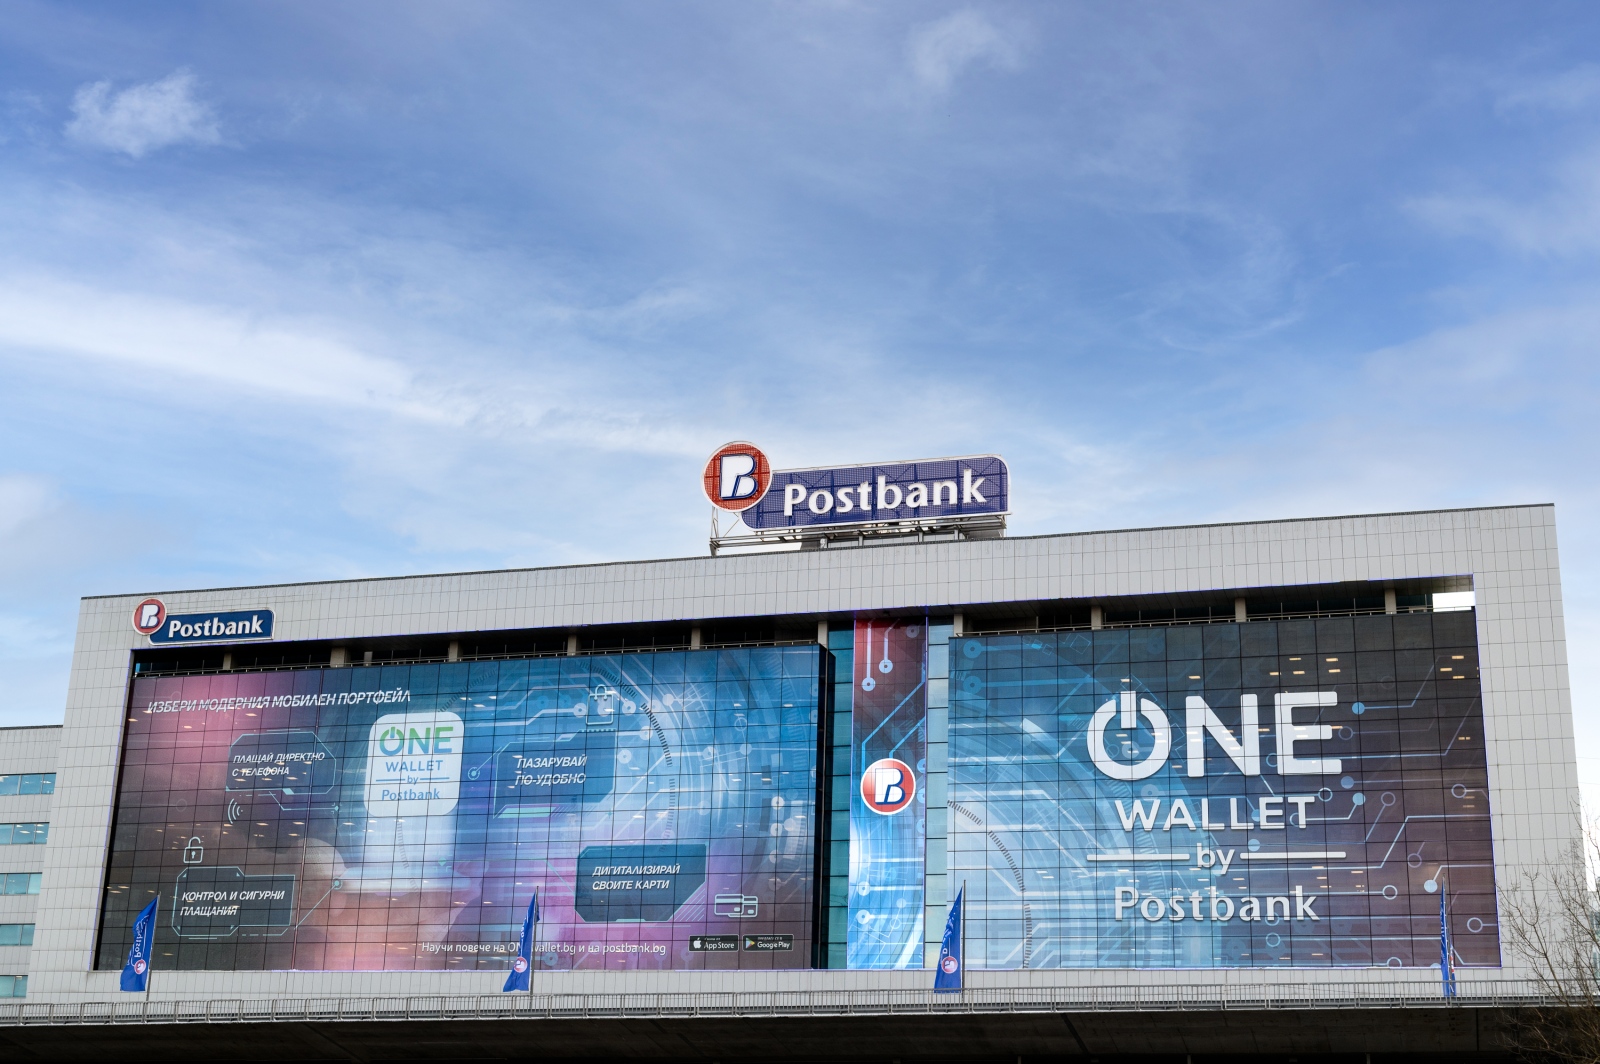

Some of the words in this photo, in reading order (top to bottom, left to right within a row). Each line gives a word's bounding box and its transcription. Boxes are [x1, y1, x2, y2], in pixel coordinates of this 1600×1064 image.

[784, 468, 987, 516] Postbank
[168, 615, 264, 638] Postbank
[148, 700, 197, 713] ИЗБЕРИ
[198, 696, 271, 713] МОДЕРНИЯ
[271, 693, 337, 708] МОБИЛЕН
[337, 687, 411, 705] ПОРТФЕЙЛ
[379, 726, 454, 756] ONE
[1086, 690, 1342, 781] ONE
[233, 752, 274, 764] ПЛАЩАЙ
[274, 752, 325, 763] ДИРЕКТНО
[517, 754, 588, 769] ПАЗАРУВАЙ
[241, 766, 290, 777] ТЕЛЕФОНА
[385, 760, 444, 772] WALLET
[406, 775, 419, 785] by
[515, 773, 586, 787] ПО-УДОБНО
[381, 788, 441, 801] Postbank
[1114, 796, 1315, 832] WALLET
[1196, 843, 1235, 875] by
[592, 863, 681, 877] ДИГИТАЛИЗИРАЙ
[592, 881, 633, 890] СВОИТЕ
[635, 880, 670, 889] КАРТИ
[182, 891, 227, 901] КОНТРОЛ
[229, 891, 238, 900] И
[239, 890, 285, 900] СИГУРНИ
[1114, 885, 1320, 921] Postbank
[180, 905, 239, 917] ПЛАЩАНИЯ
[421, 941, 453, 954] Научи
[455, 944, 491, 952] повече
[493, 944, 505, 952] на
[578, 944, 585, 952] и
[588, 944, 600, 952] на
[602, 942, 667, 955] postbank.bg
[704, 941, 718, 950] App
[718, 941, 735, 949] Store
[757, 941, 777, 950] Google
[778, 941, 791, 949] Play
